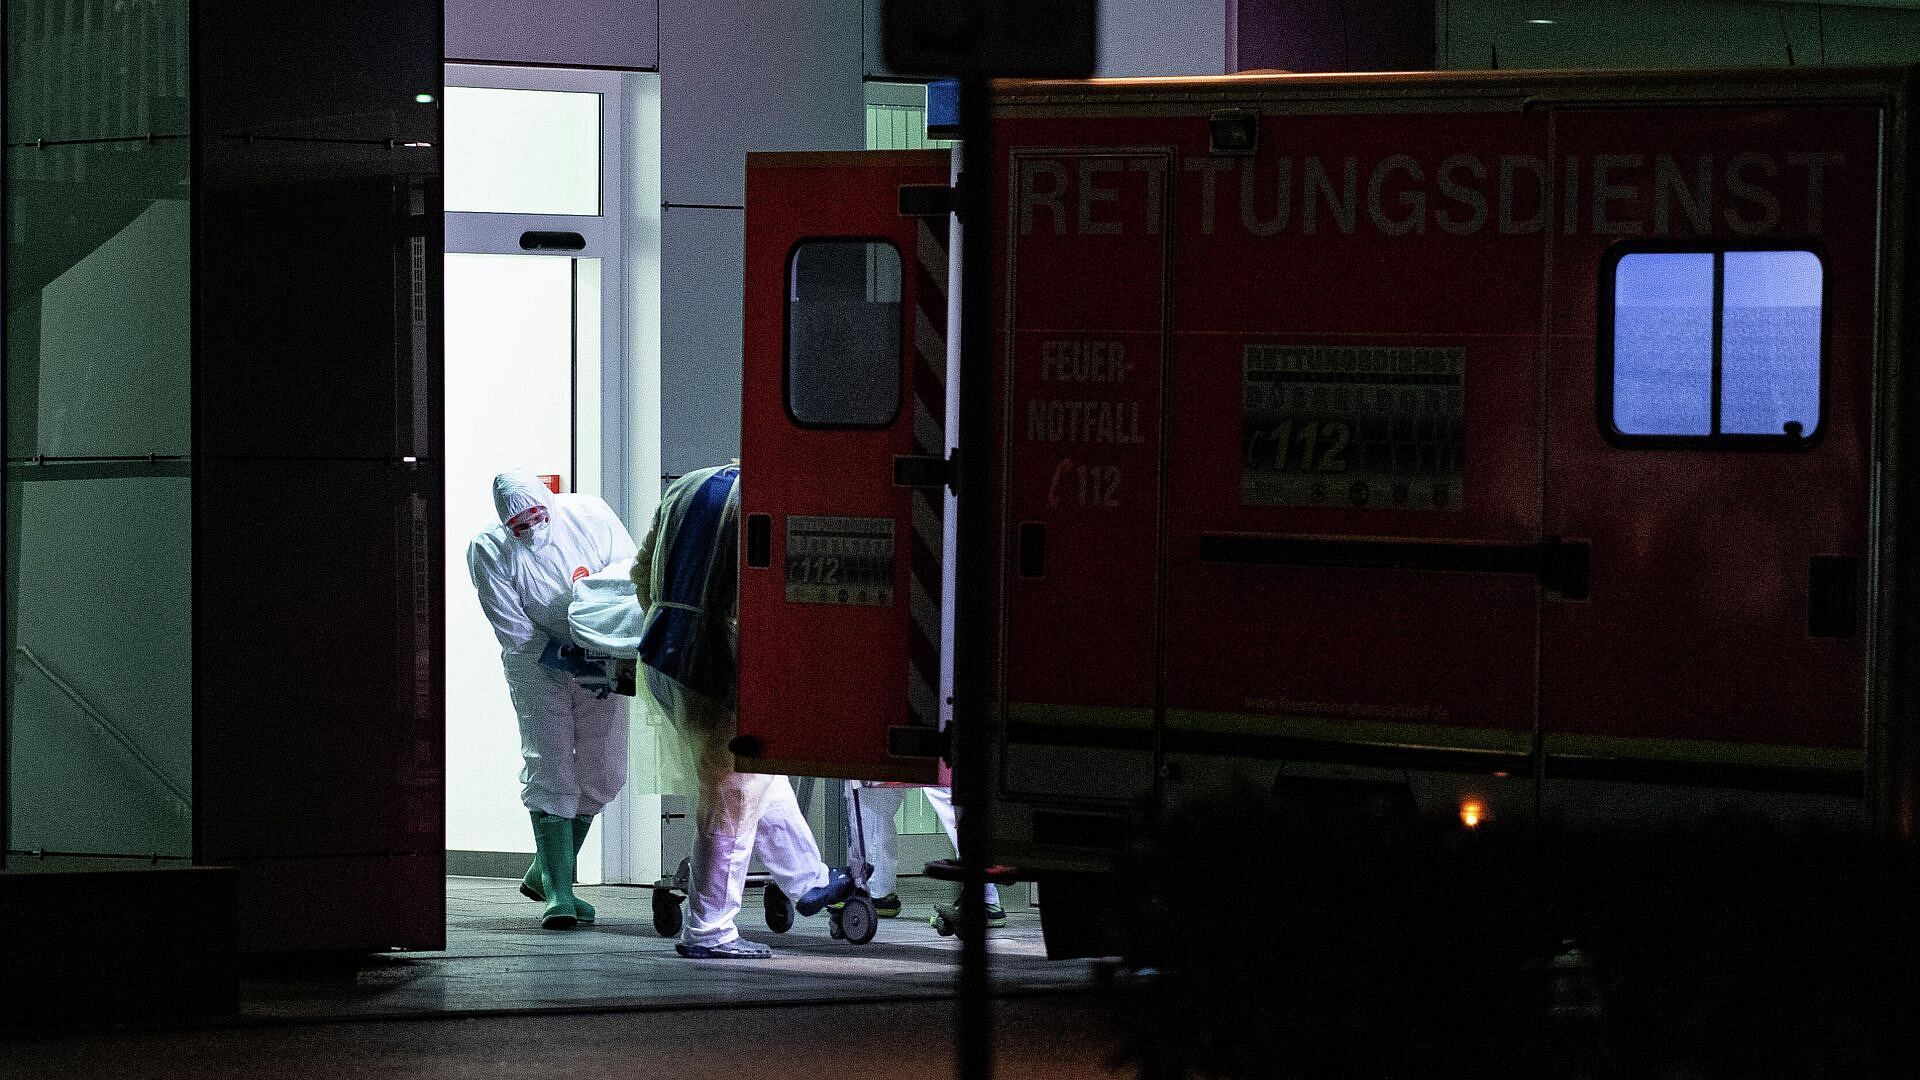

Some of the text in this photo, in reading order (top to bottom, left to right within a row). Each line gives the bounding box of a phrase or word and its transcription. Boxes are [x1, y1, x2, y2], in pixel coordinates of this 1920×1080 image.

[1020, 153, 1845, 236] RETTUNGSDIENST
[1041, 340, 1135, 383] FEUER-
[1027, 399, 1145, 444] NOTFALL
[1269, 419, 1350, 472] 112
[1076, 464, 1121, 507] 112
[800, 556, 840, 584] 112
